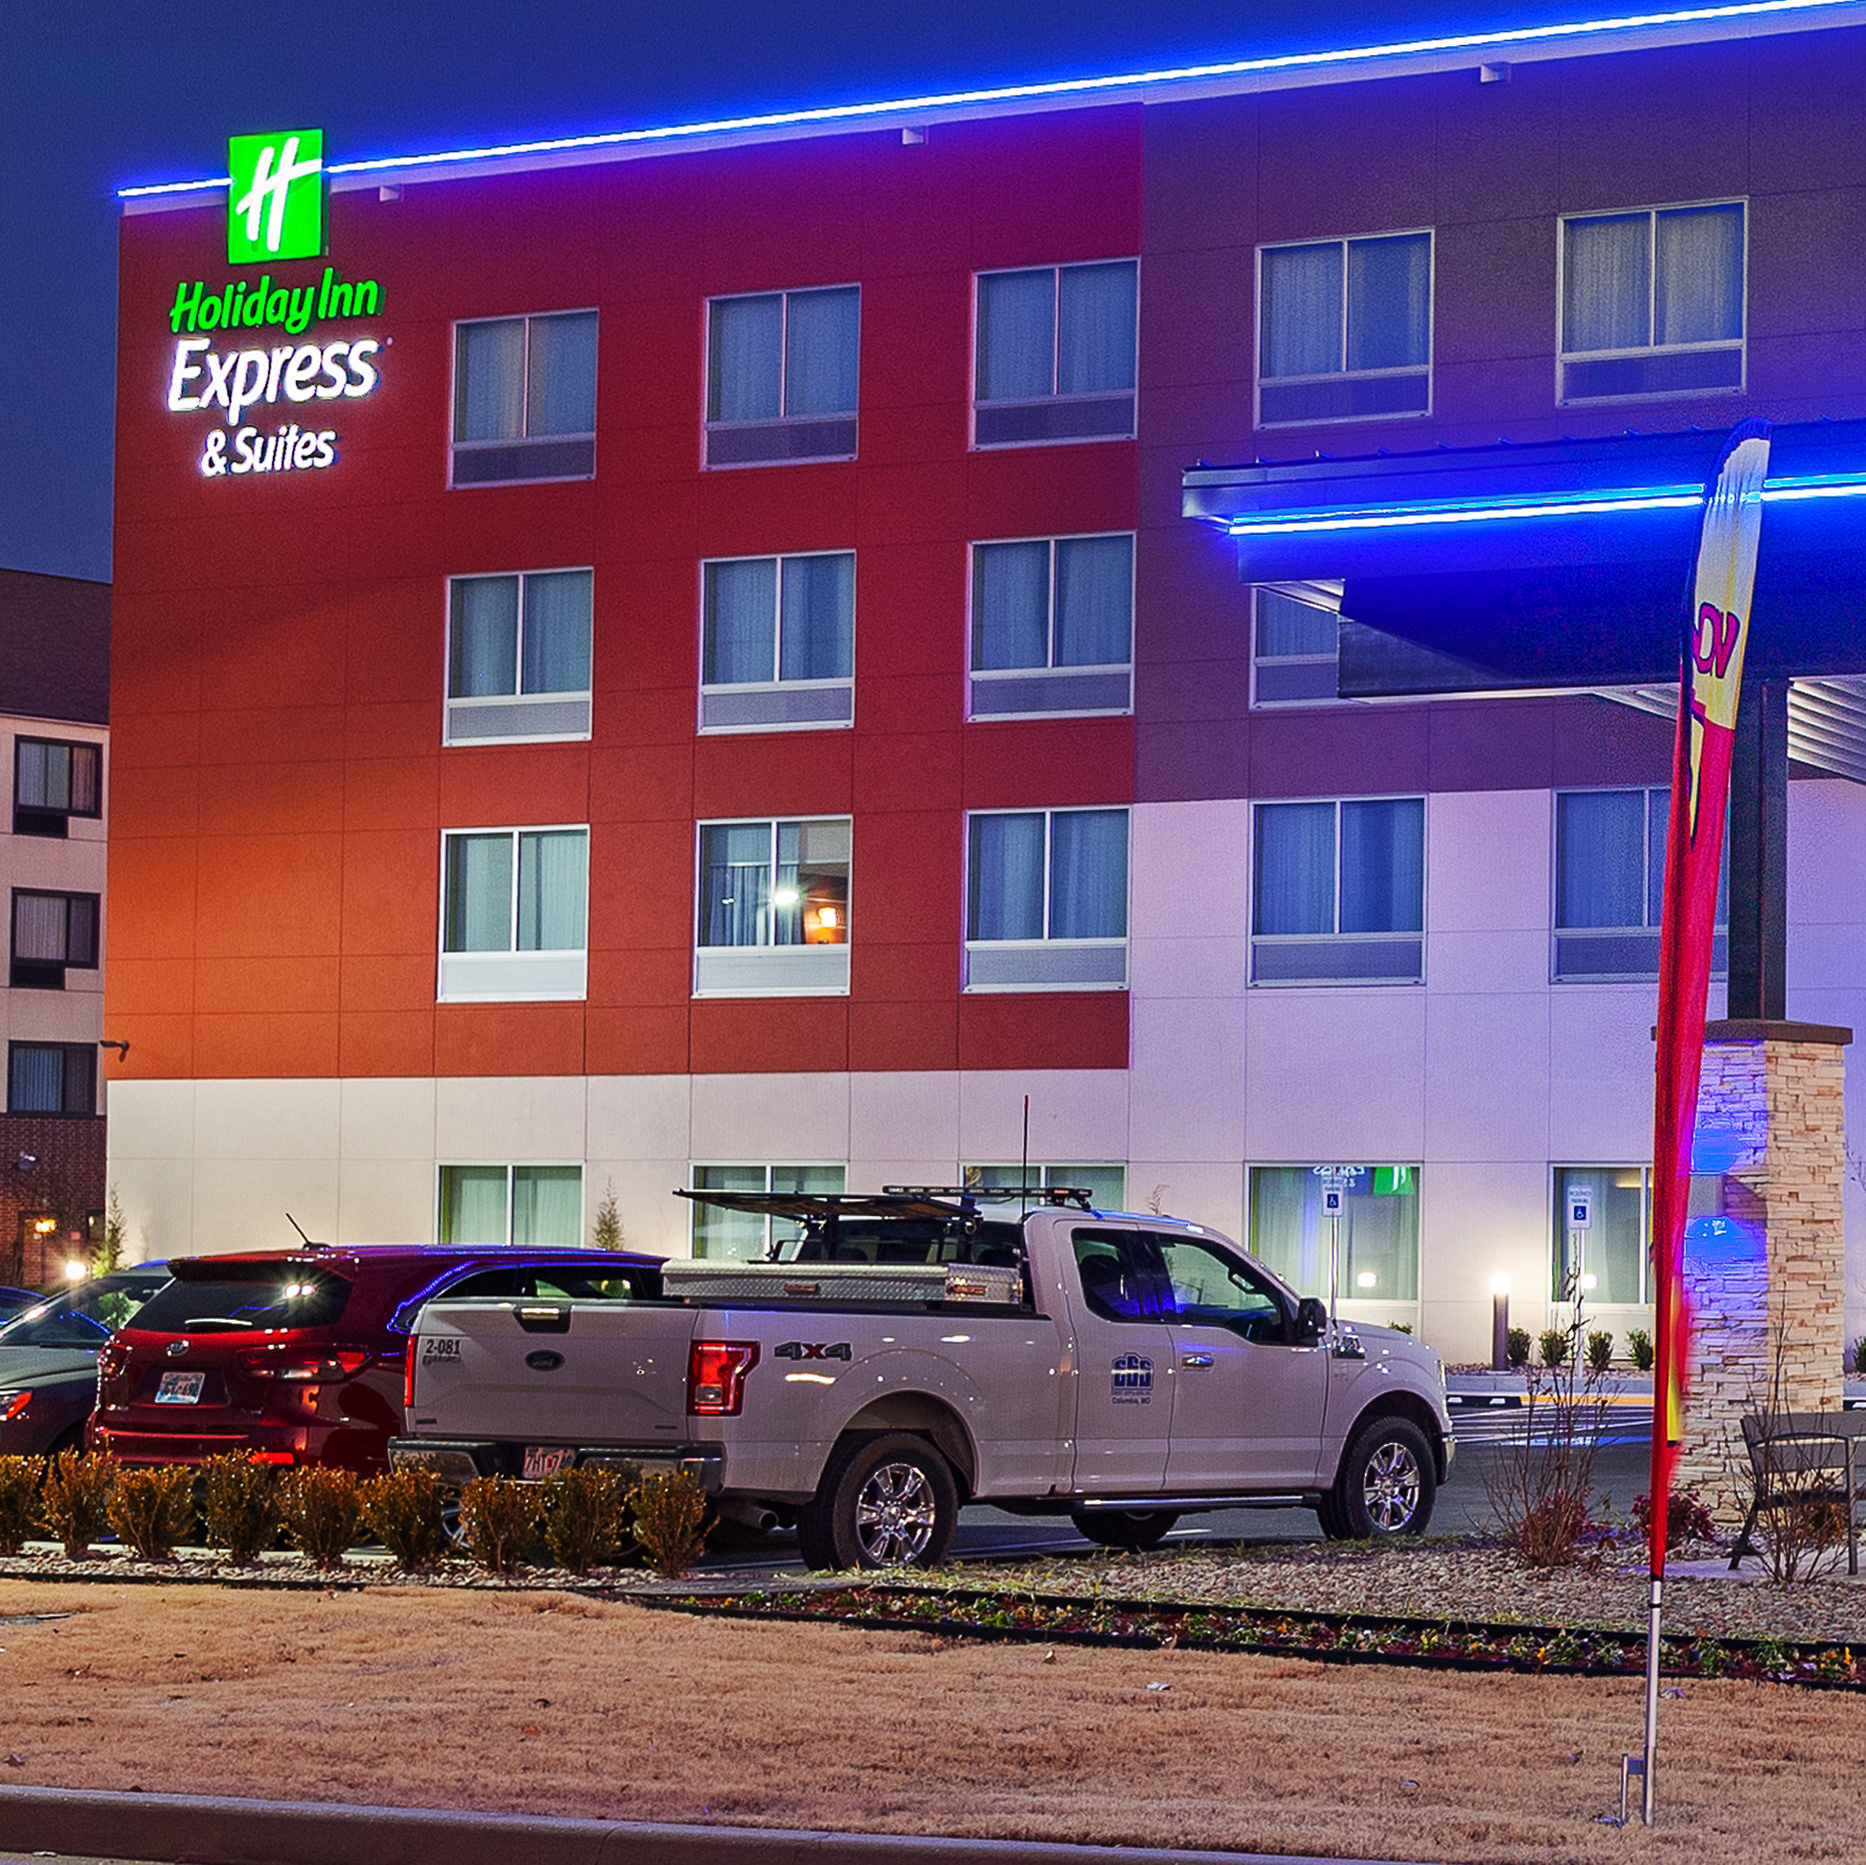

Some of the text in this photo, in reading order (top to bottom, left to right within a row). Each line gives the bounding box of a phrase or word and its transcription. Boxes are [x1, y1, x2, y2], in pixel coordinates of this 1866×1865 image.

[169, 267, 379, 334] Holiday Inn
[167, 337, 379, 426] Express
[200, 424, 336, 477] & Suites
[426, 1339, 461, 1354] 2-081
